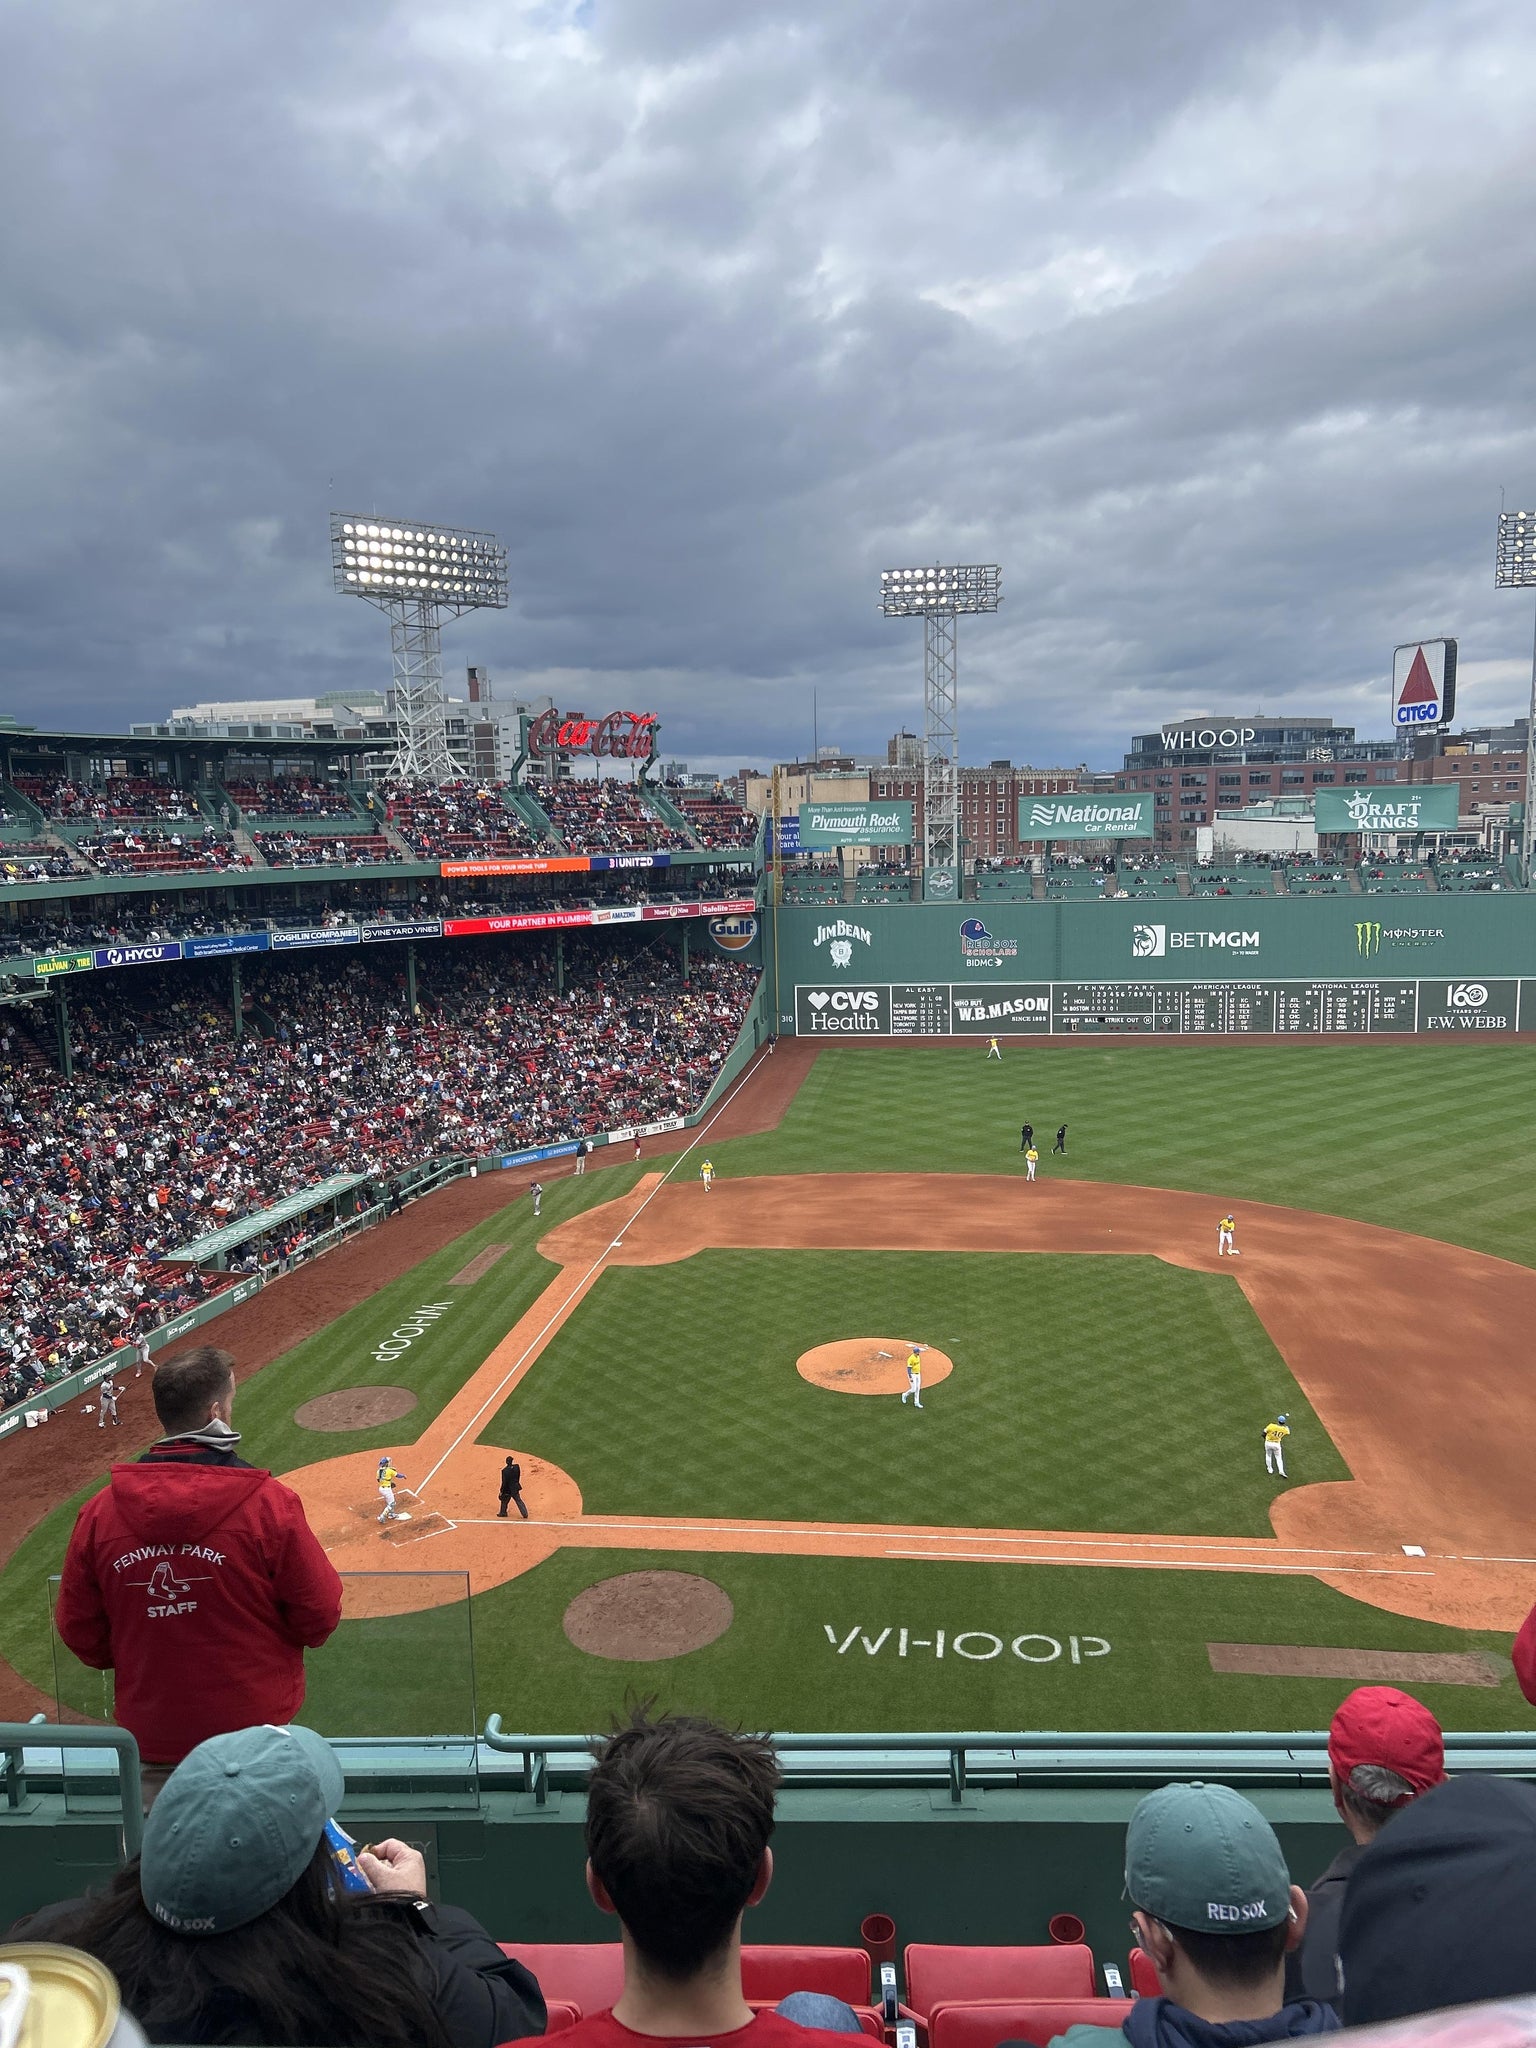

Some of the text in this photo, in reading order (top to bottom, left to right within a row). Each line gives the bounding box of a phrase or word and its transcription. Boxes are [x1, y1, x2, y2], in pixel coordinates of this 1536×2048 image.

[1397, 703, 1438, 723] CITGO
[1161, 728, 1255, 749] WHOOP
[1348, 803, 1421, 820] DRAFT
[811, 813, 900, 829] Plymouth Rock
[1084, 822, 1137, 832] Car Rental
[1357, 816, 1419, 829] KINGS
[619, 857, 653, 867] UNITED
[612, 911, 635, 919] AMAZING
[702, 905, 728, 913] Safelite
[488, 919, 511, 929] YOUR
[512, 917, 546, 927] PARTNER
[548, 916, 555, 924] IN
[557, 914, 592, 924] PLUMBING
[710, 920, 754, 936] Gulf
[273, 933, 310, 942] COGHLIN
[311, 929, 358, 939] COMPANIES
[372, 925, 439, 937] VINEYARD VINES
[813, 919, 872, 947] JIM BEAM
[966, 940, 1018, 948] RED SOX
[1170, 932, 1259, 948] BETMGM
[125, 948, 162, 961] HYCU
[966, 948, 1018, 956] SCHOLARS
[37, 958, 91, 973] SULLIVAN TIRE
[966, 958, 993, 967] BIDMC
[831, 991, 878, 1010] CVS
[1447, 984, 1488, 1007] 160
[810, 1013, 879, 1031] Health
[1427, 1016, 1507, 1029] F.W. WEBB
[553, 1145, 578, 1154] HONDA
[512, 1154, 538, 1164] HONDA
[370, 1301, 454, 1361] WHOOP
[83, 1360, 118, 1385] smartwater
[112, 1543, 227, 1573] FENWAY PARK
[147, 1601, 197, 1618] STAFF
[823, 1624, 1111, 1664] WHOOP
[1208, 1900, 1267, 1921] RED SOX
